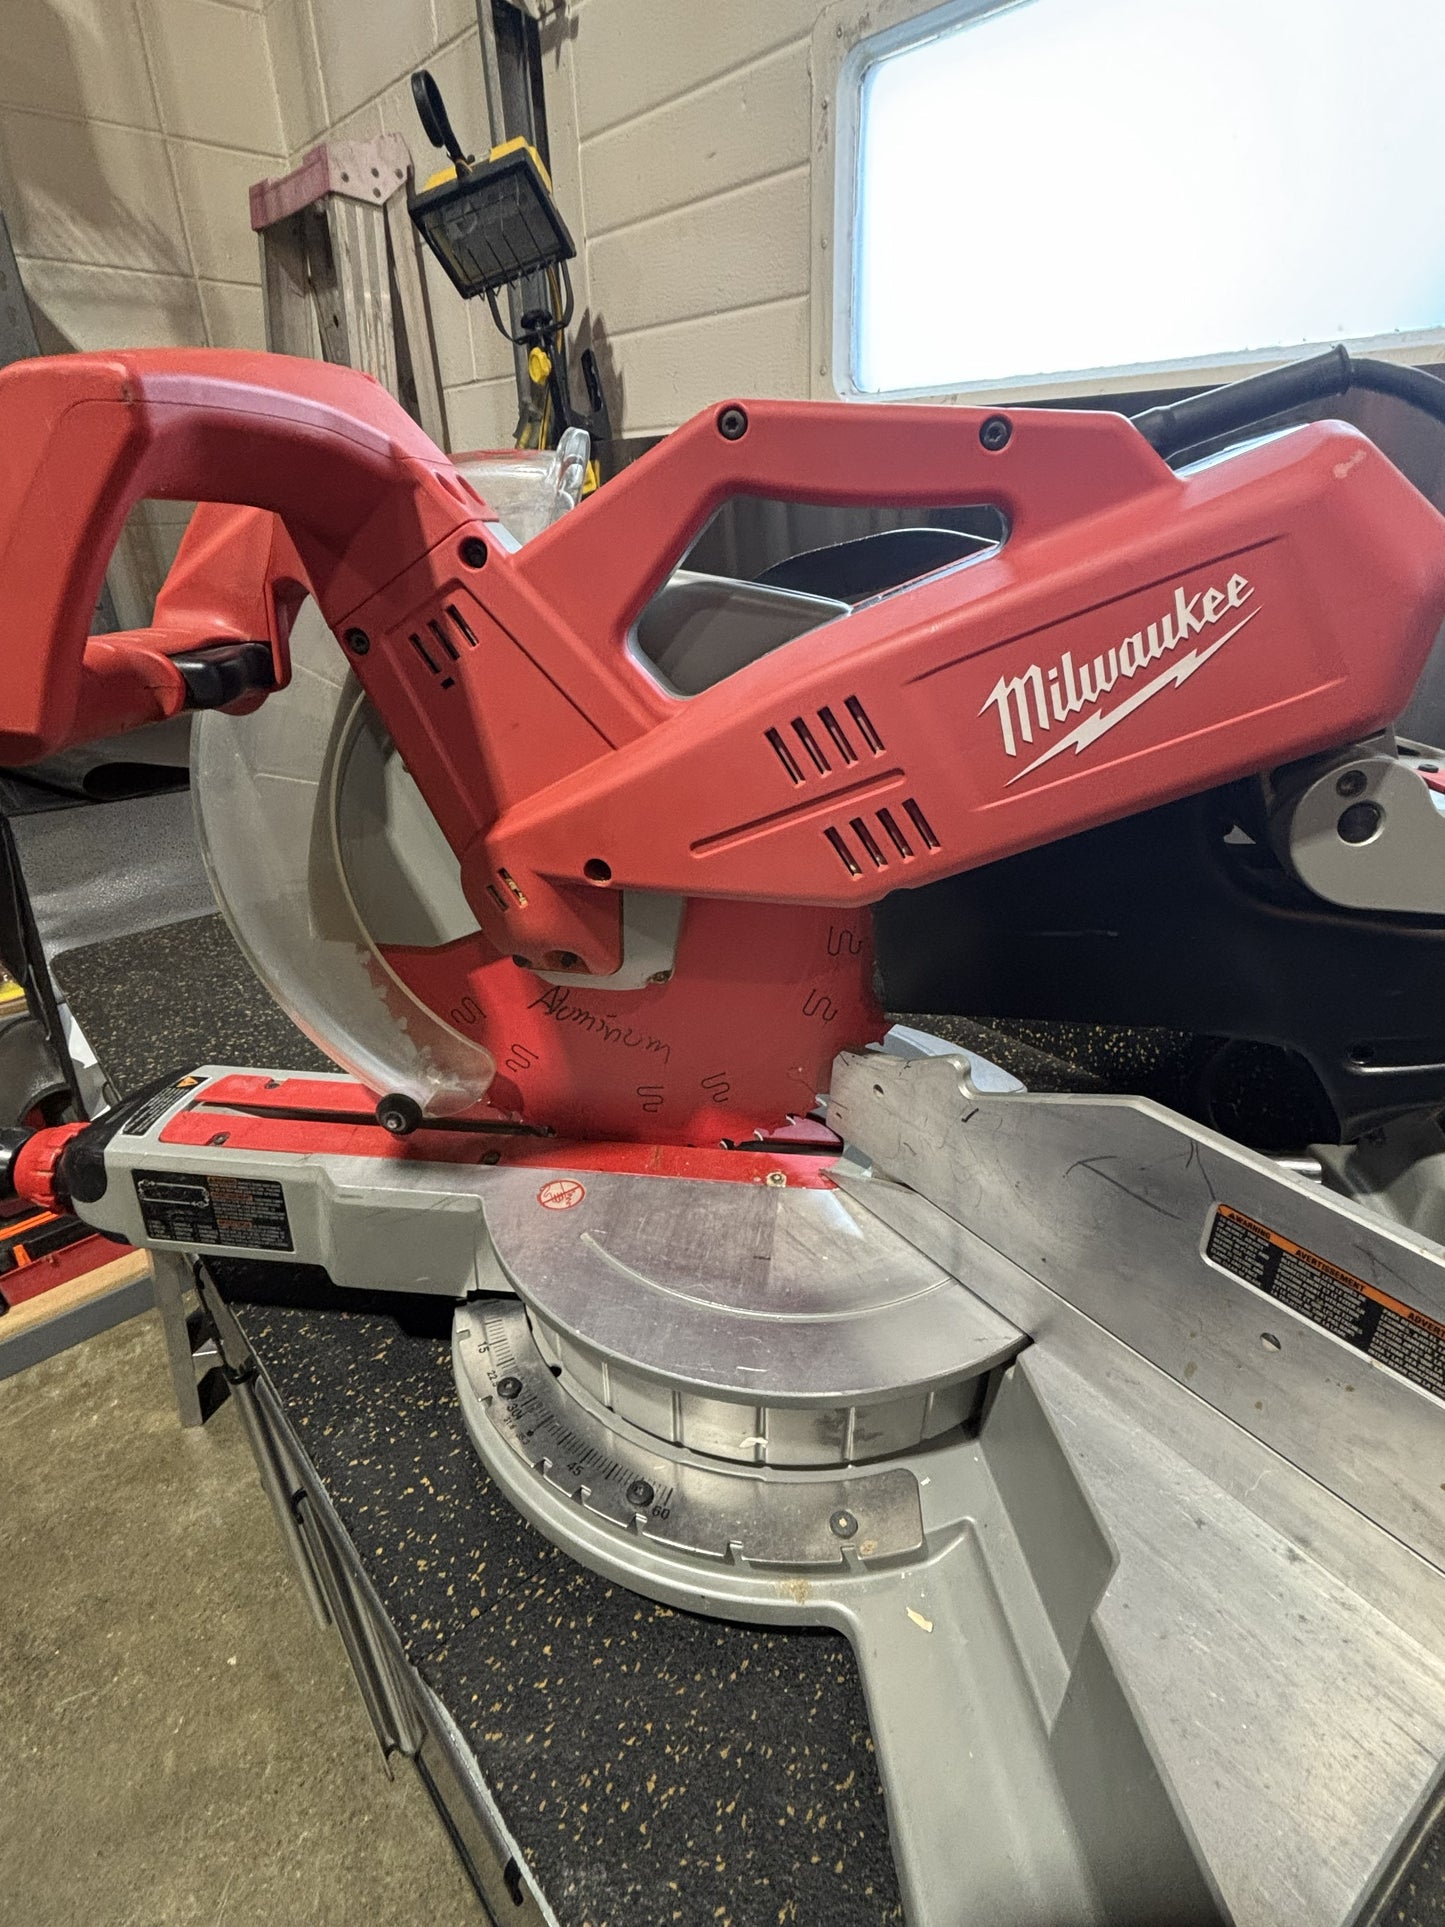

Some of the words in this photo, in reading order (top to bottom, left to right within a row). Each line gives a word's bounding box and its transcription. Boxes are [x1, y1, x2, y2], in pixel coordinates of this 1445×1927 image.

[977, 573, 1255, 757] Milwaukee
[1233, 1214, 1271, 1240] WARNING
[1295, 1249, 1365, 1291] AVERTISSEMENT
[478, 1341, 490, 1354] 15
[567, 1461, 584, 1476] 45
[652, 1505, 671, 1520] 60
